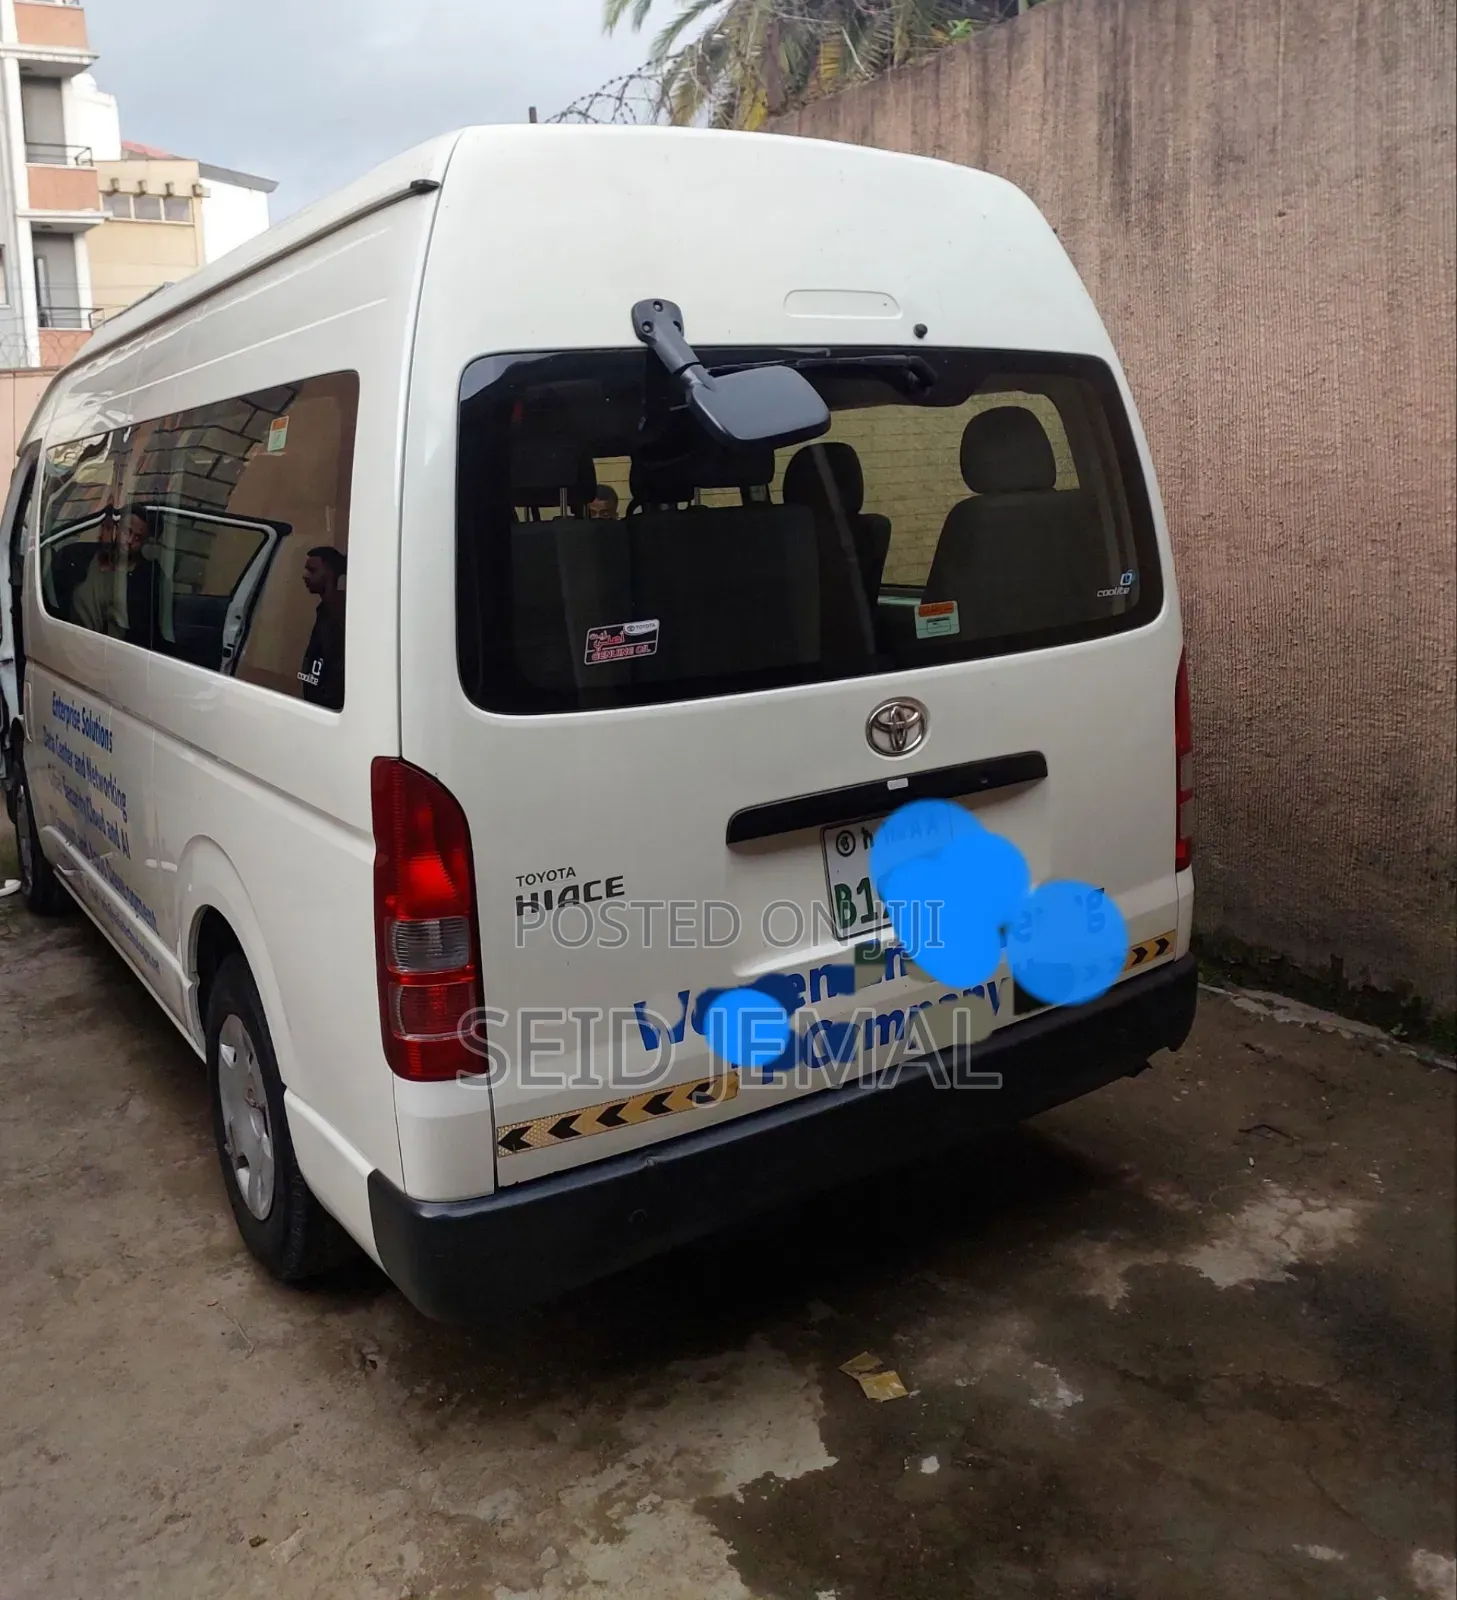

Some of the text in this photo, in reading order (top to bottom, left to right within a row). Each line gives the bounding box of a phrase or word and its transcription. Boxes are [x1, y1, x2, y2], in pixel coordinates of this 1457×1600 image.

[635, 622, 656, 630] TOYOTA
[591, 645, 651, 661] GENUINE OIL
[53, 690, 113, 754] Enterprise Solutions
[86, 756, 128, 824] Networking
[516, 866, 576, 887] TOYOTA
[515, 875, 625, 916] HIACE
